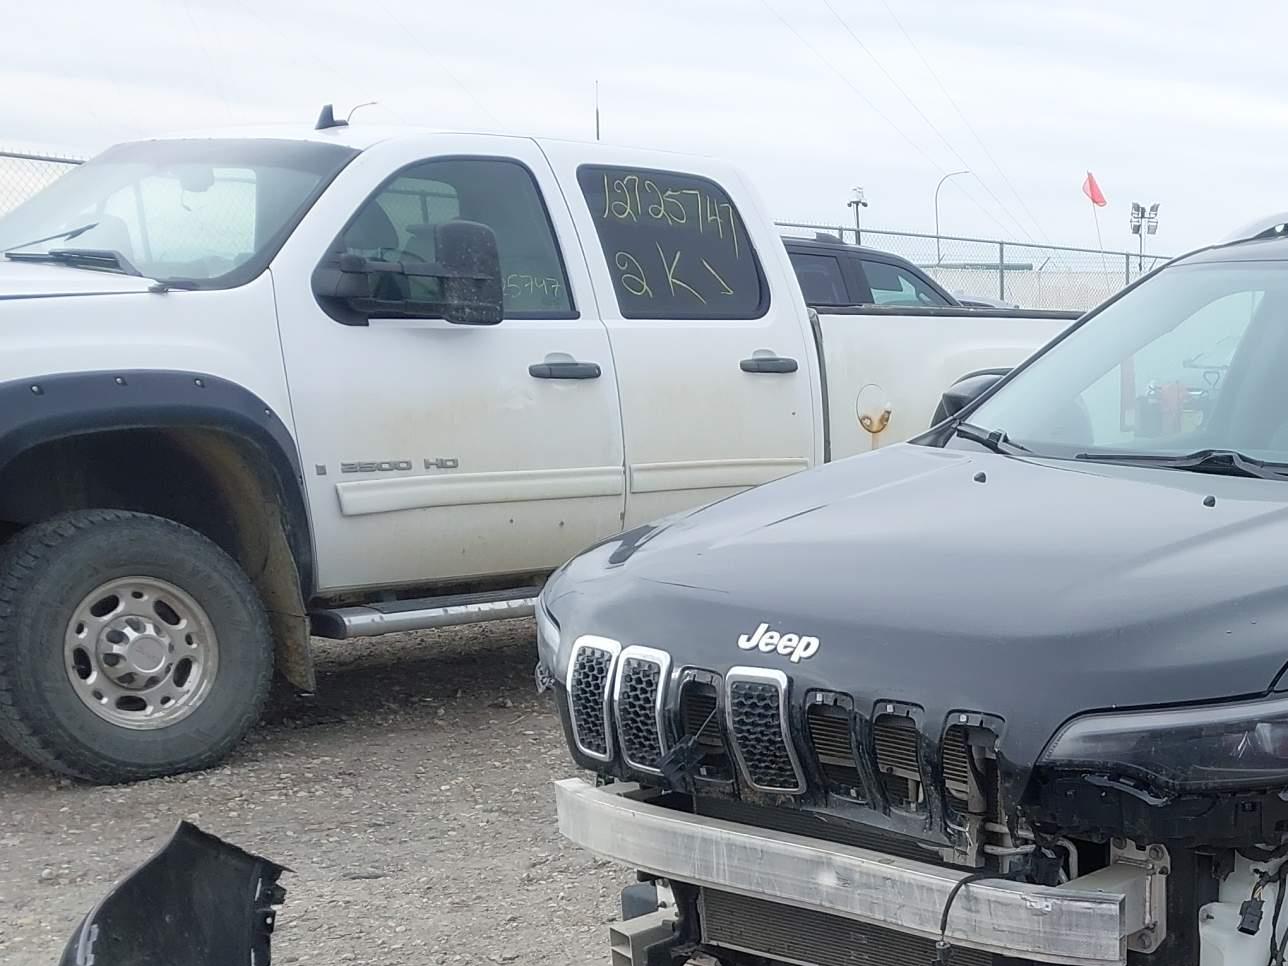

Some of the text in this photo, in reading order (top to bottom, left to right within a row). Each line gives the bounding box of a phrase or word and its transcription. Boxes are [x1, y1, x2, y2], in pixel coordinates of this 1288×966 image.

[603, 173, 739, 259] 12725747
[341, 458, 458, 473] 2500 HD
[737, 622, 820, 663] Jeep
